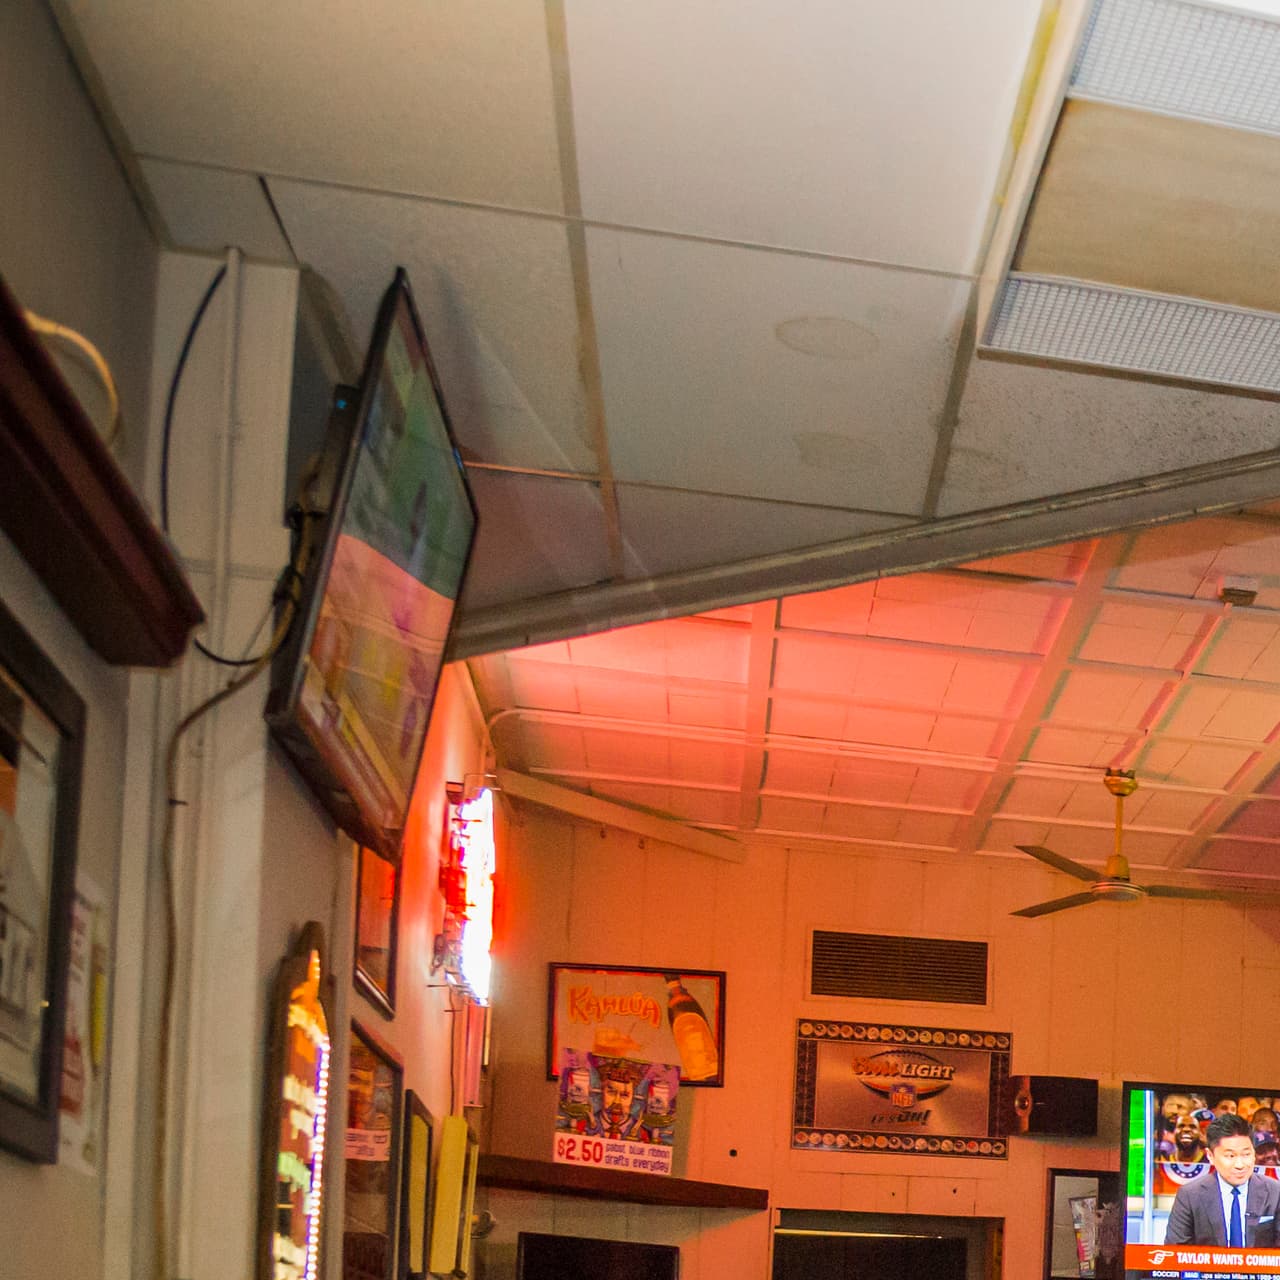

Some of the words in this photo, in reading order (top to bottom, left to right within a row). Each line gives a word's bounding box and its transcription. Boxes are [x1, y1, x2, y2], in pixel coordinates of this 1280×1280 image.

[901, 1062, 955, 1081] LIGHT
[557, 1137, 604, 1164] $2.50
[605, 1155, 629, 1167] drafts
[632, 1157, 670, 1173] everyday
[1176, 1251, 1210, 1264] TAYLOR
[1212, 1253, 1244, 1266] WANTS
[1152, 1270, 1180, 1278] SOCCER
